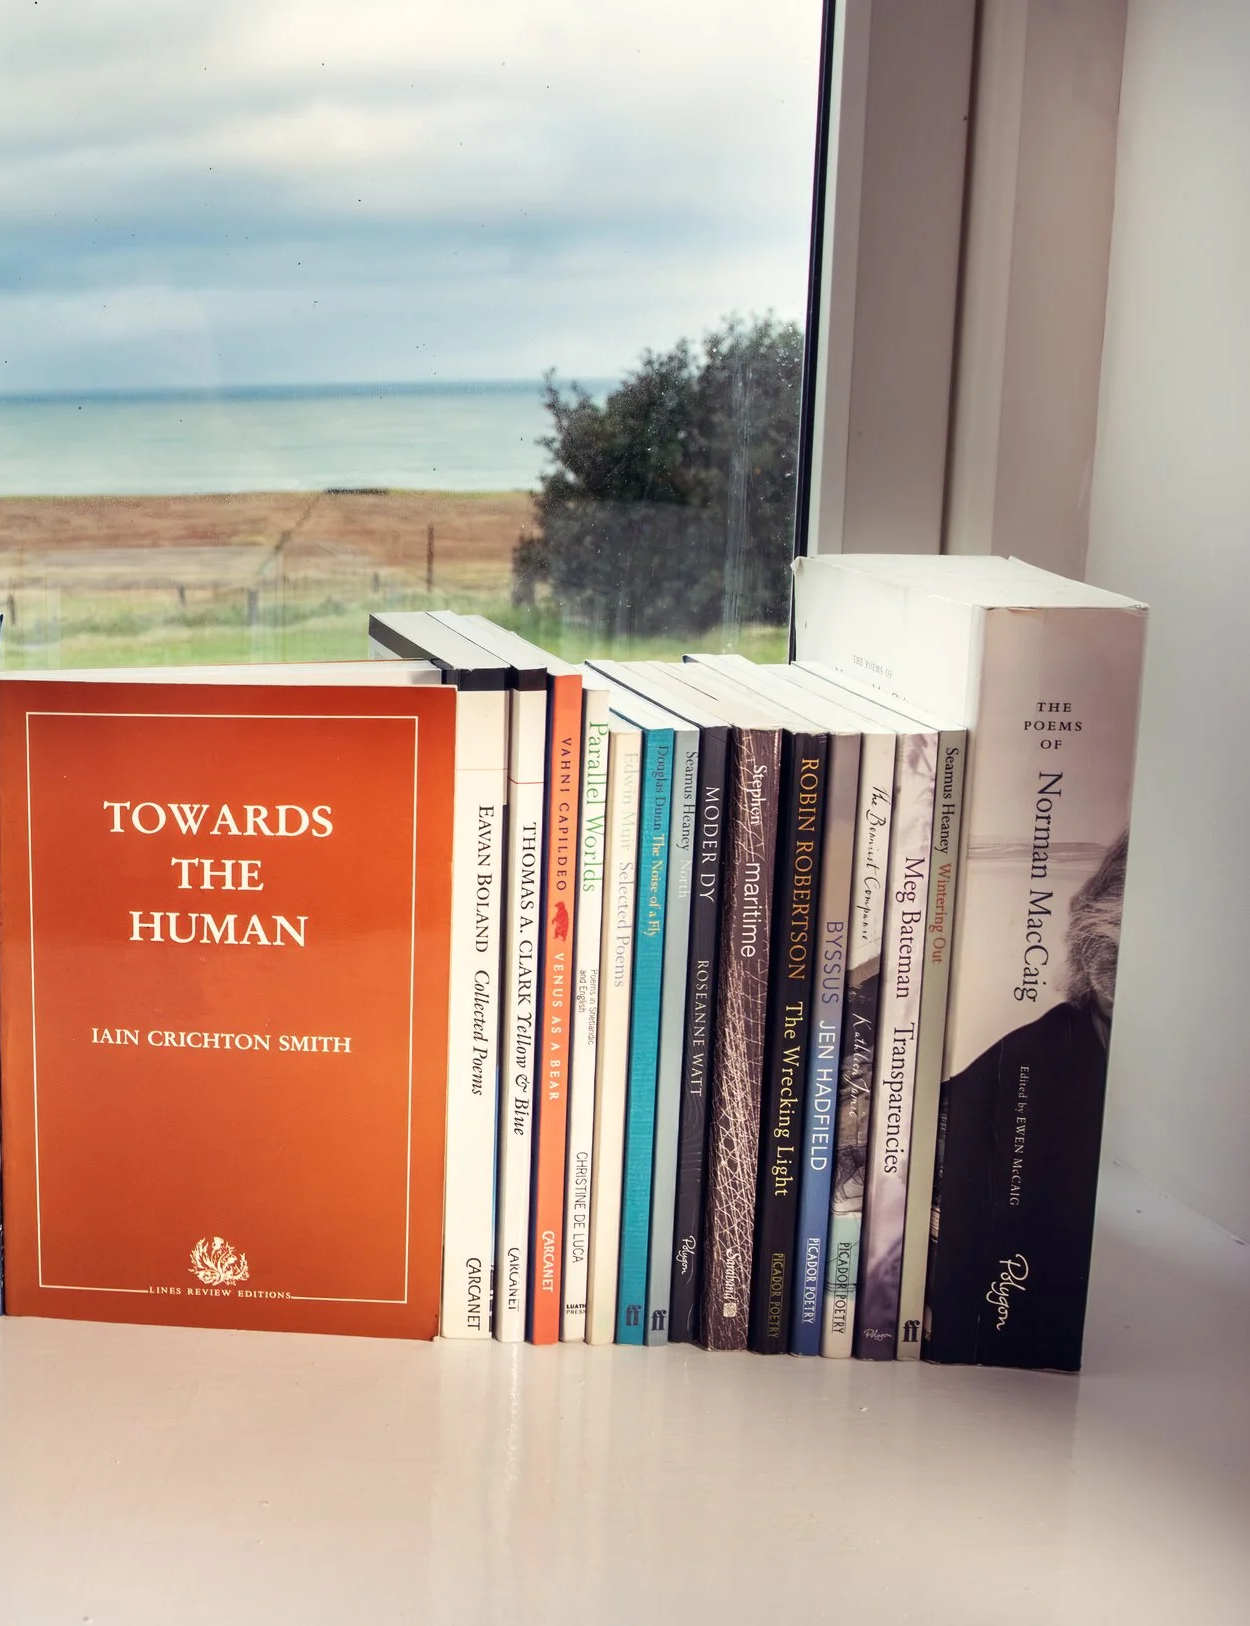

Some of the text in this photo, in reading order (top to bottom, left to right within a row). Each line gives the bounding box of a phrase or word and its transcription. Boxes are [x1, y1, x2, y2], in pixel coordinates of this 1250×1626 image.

[1023, 720, 1083, 732] POEMS
[1036, 702, 1072, 713] THE
[1040, 739, 1062, 750] OF
[103, 800, 334, 838] TOWARDS
[556, 737, 572, 891] VAHNI CAPILDEO
[583, 721, 609, 893] Parallel Worlds
[652, 746, 670, 831] Douglas Dunn
[676, 751, 700, 852] Seamus Heaney
[934, 747, 959, 854] Seamus Heaney
[171, 857, 264, 891] THE
[475, 804, 494, 953] EAVAN BOLAND
[643, 834, 666, 938] The Noise of Fly
[700, 786, 720, 903] MODER DY
[788, 758, 820, 980] ROBIN ROBERTSON
[1013, 771, 1064, 1003] Norman MacCaig
[128, 911, 309, 948] HUMAN
[518, 821, 537, 1007] THOMAS CLARK
[614, 861, 634, 988] Selected Poems
[740, 862, 763, 958] maritime
[821, 921, 844, 1004] BYSSUS
[895, 857, 926, 999] Meg Bateman
[928, 862, 952, 964] Wintering Out
[91, 1027, 352, 1053] IAIN CRICHTON SMITH
[471, 969, 491, 1096] Collected Poems
[513, 1012, 532, 1136] Yellow & Blue
[548, 952, 565, 1100] VENUS AS BEAR
[690, 960, 710, 1097] ROSEANNE WATT
[771, 1001, 804, 1196] The Wrecking Light
[810, 1020, 836, 1171] JEN HADFIELD
[882, 1022, 916, 1174] Transparencies
[1014, 1065, 1030, 1154] Edited EWEN
[572, 1151, 588, 1263] CHRISTINE LUCA
[150, 1286, 291, 1299] LINES REVIEW EDITIONS
[903, 1319, 921, 1342] ff
[986, 1253, 1029, 1331] Polygon
